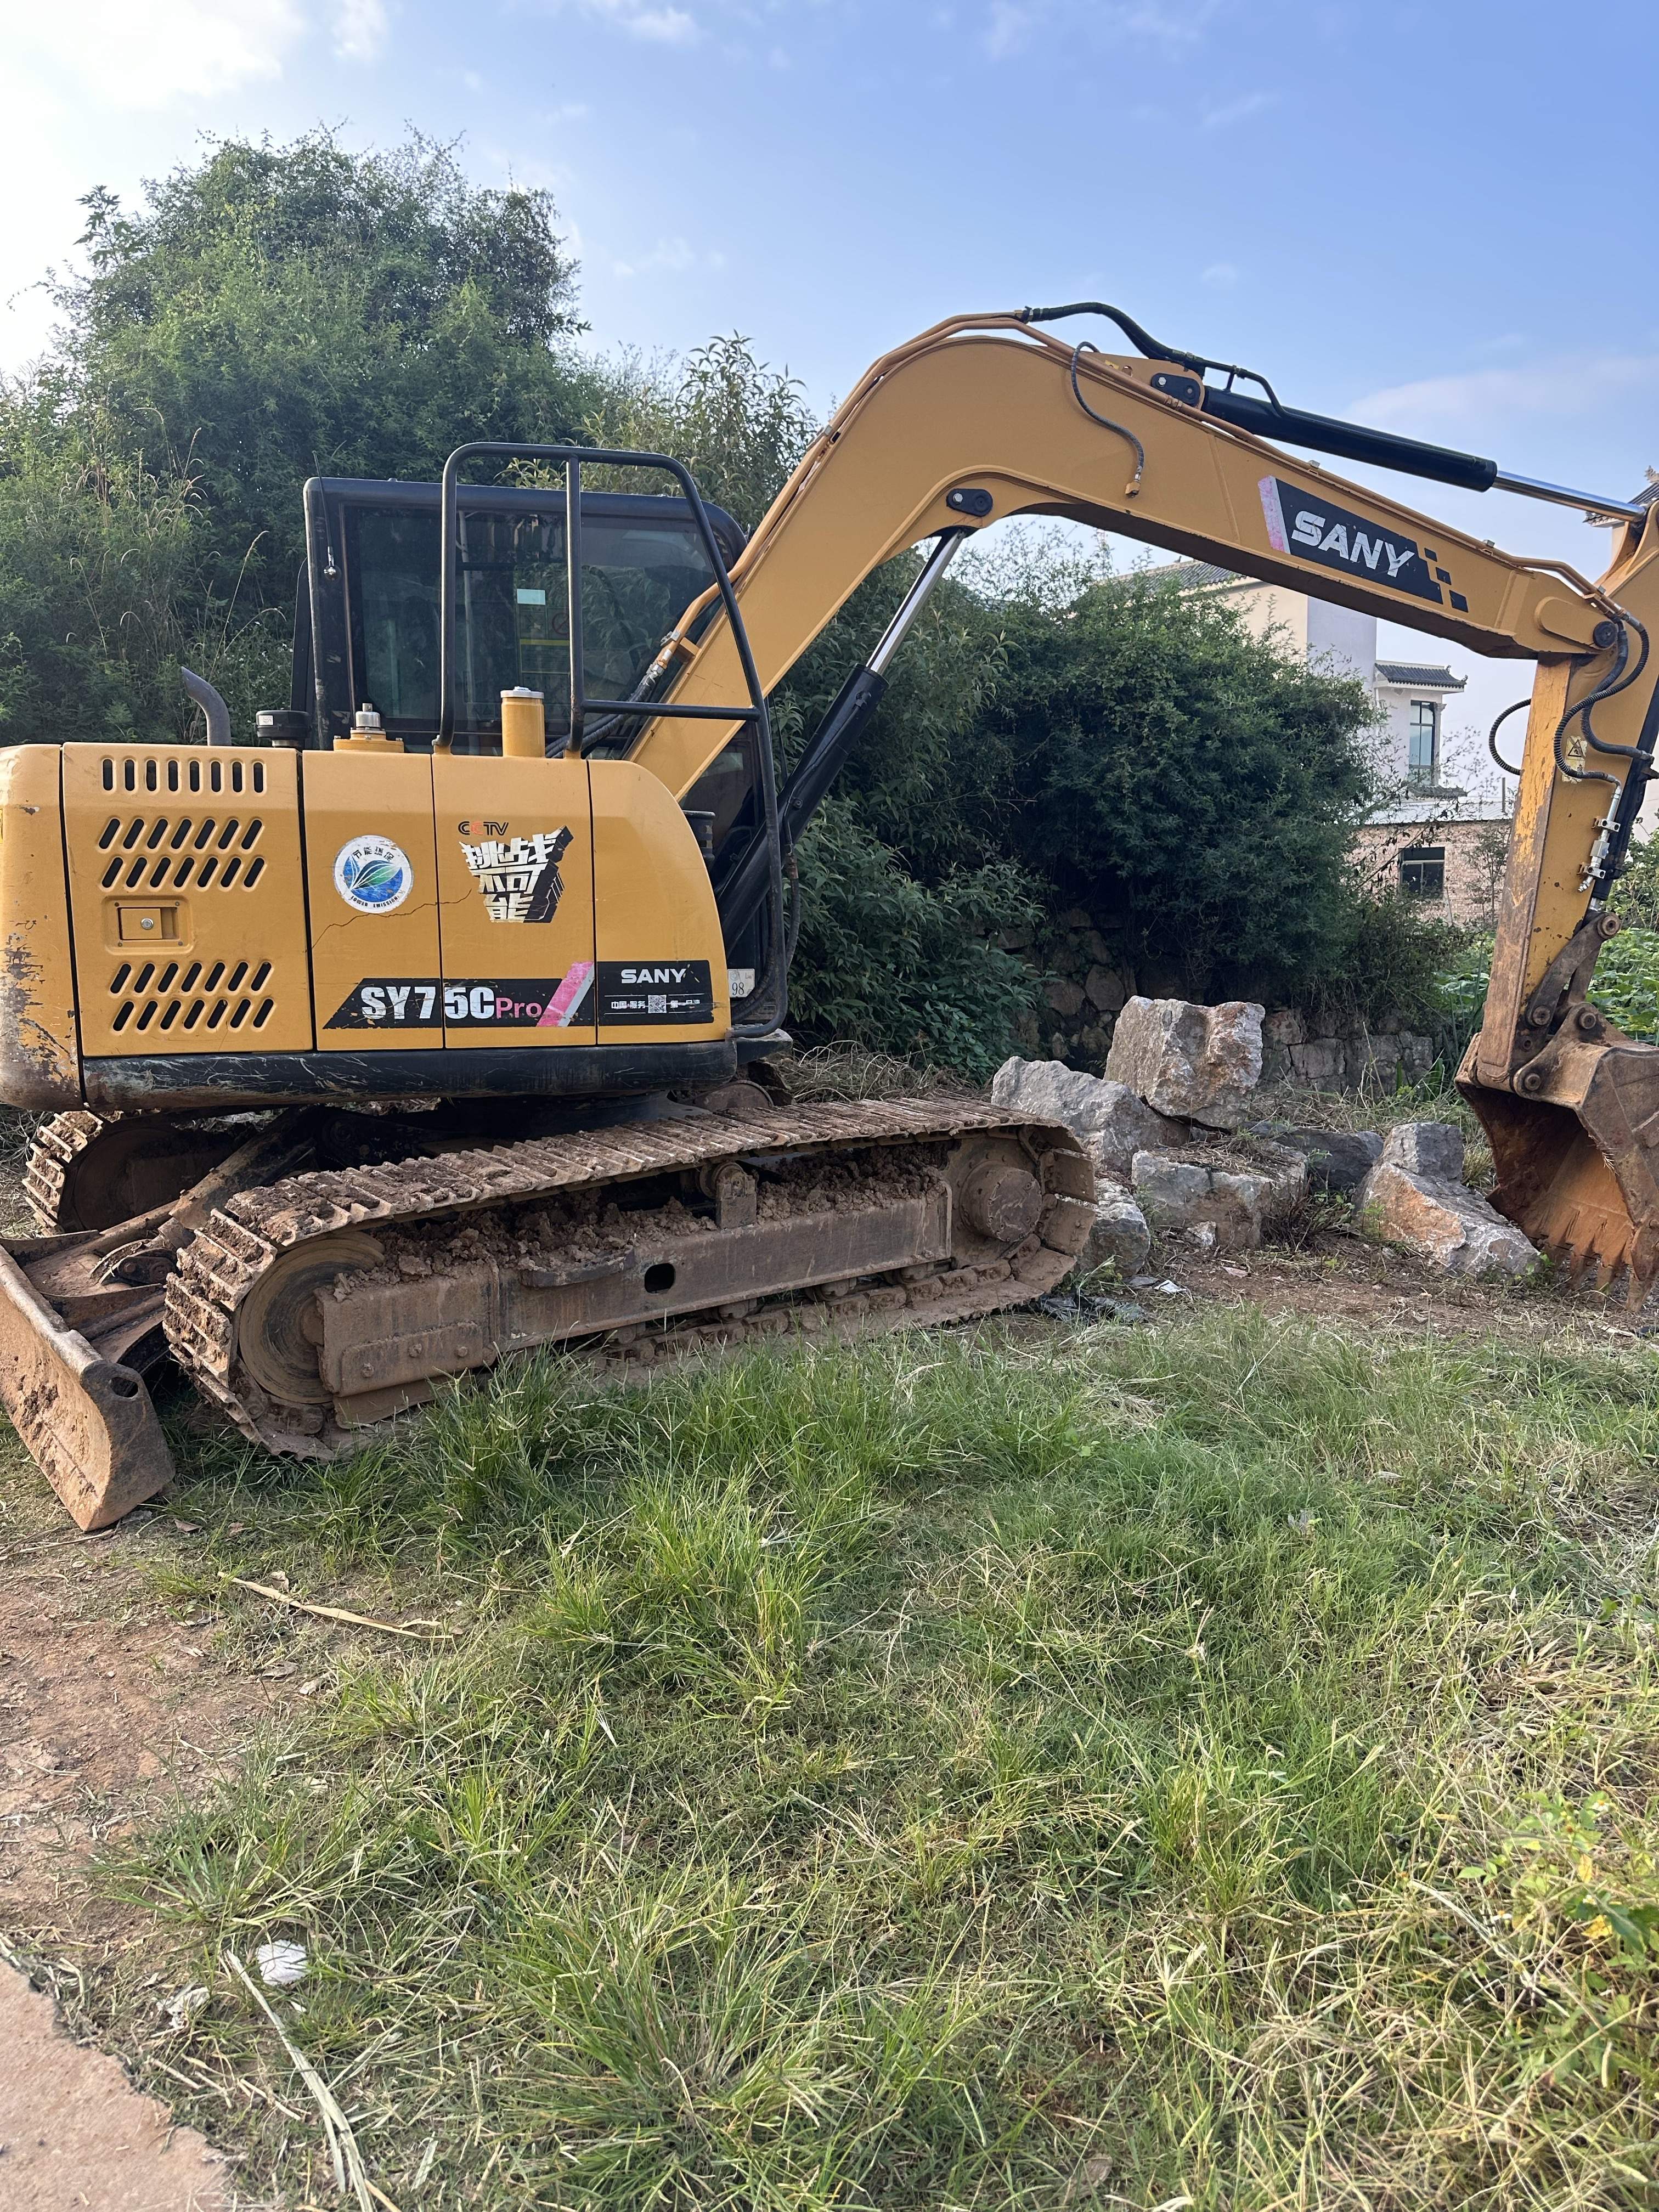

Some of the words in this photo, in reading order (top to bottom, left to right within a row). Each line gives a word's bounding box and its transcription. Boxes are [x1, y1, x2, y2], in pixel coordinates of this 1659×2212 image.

[1291, 510, 1415, 578] SANY
[458, 821, 509, 836] CCTV
[458, 825, 565, 870] 挑战
[351, 895, 368, 907] LOWER
[620, 968, 686, 984] SANY
[732, 982, 744, 996] 98
[496, 997, 542, 1018] Pro
